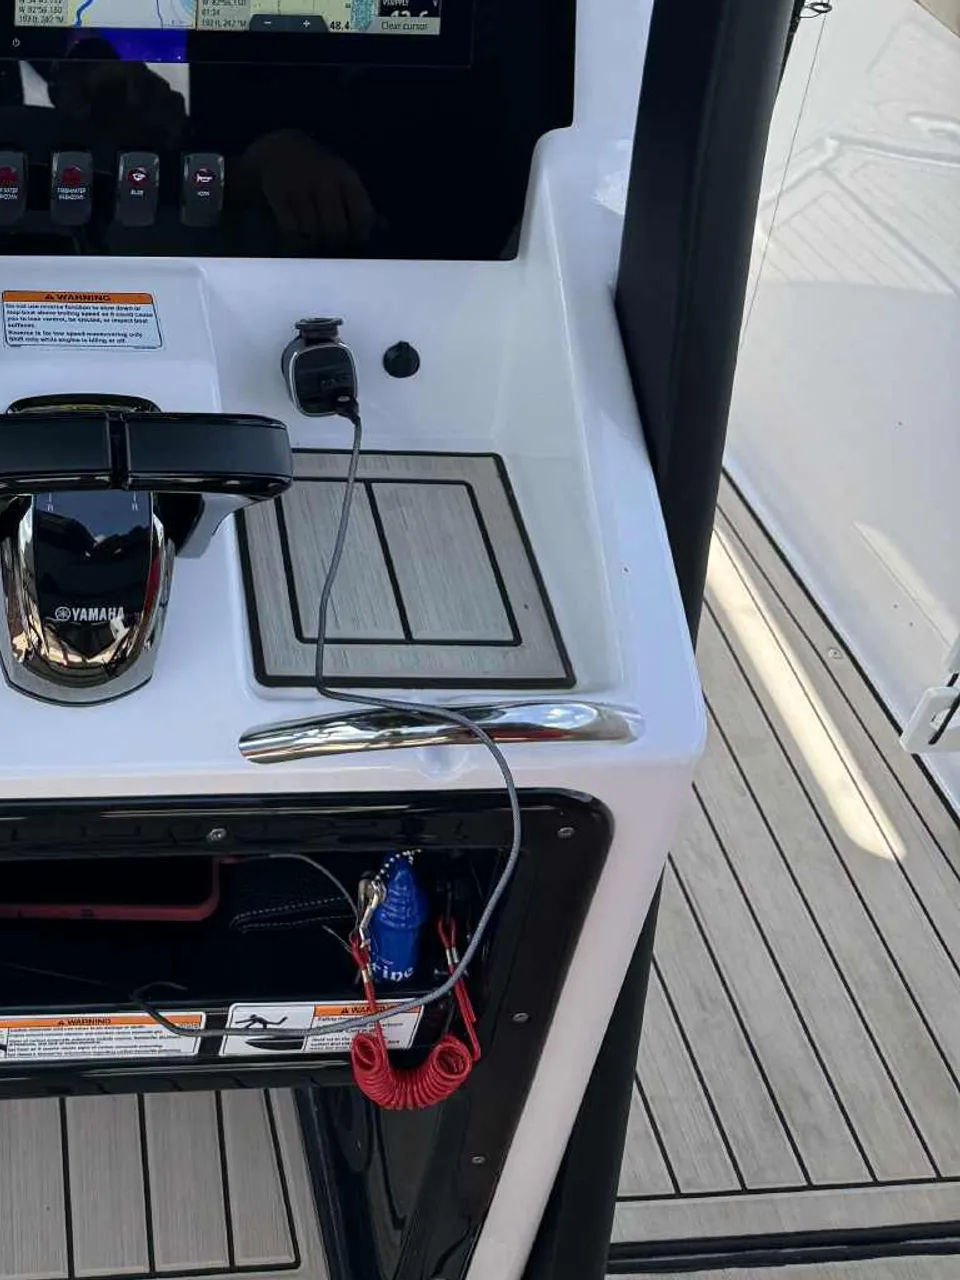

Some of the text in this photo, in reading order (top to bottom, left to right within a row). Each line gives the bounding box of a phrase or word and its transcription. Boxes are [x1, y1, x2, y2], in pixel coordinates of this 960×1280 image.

[58, 294, 111, 302] WARNING
[72, 607, 125, 621] YAMAHA
[67, 1018, 111, 1026] WARNING
